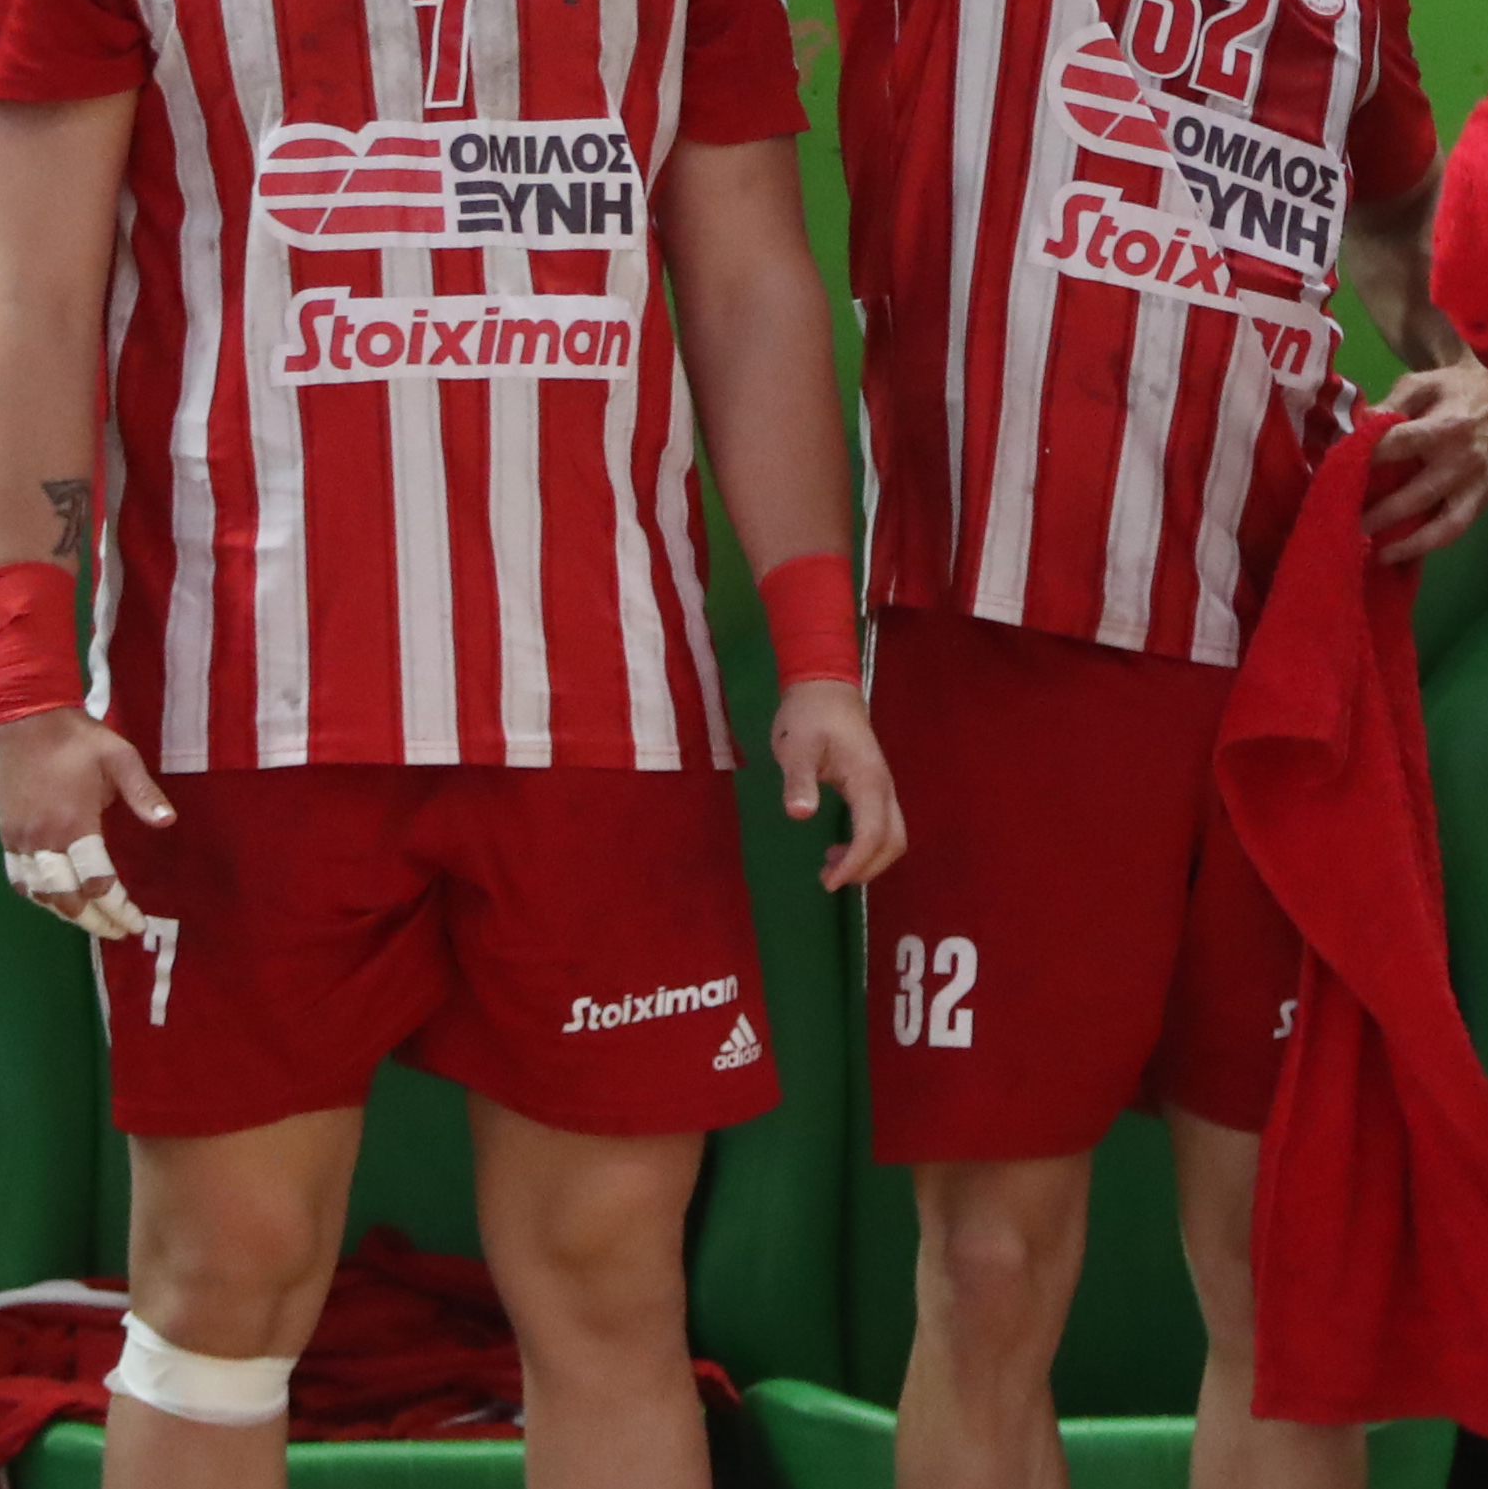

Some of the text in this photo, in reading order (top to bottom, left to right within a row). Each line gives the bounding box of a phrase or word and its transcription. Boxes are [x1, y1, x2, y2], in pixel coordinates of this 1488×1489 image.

[449, 133, 633, 174] ΟΜΙΛΟΣ
[1173, 116, 1339, 211] ΟΜΙΛΟΣ
[454, 180, 634, 235] ΞΥΝΗ
[1043, 193, 1313, 376] Stoixn
[284, 298, 632, 373] Stoiximan
[142, 916, 179, 1027] 7
[562, 973, 740, 1034] Stoiximan
[893, 934, 979, 1048] 32
